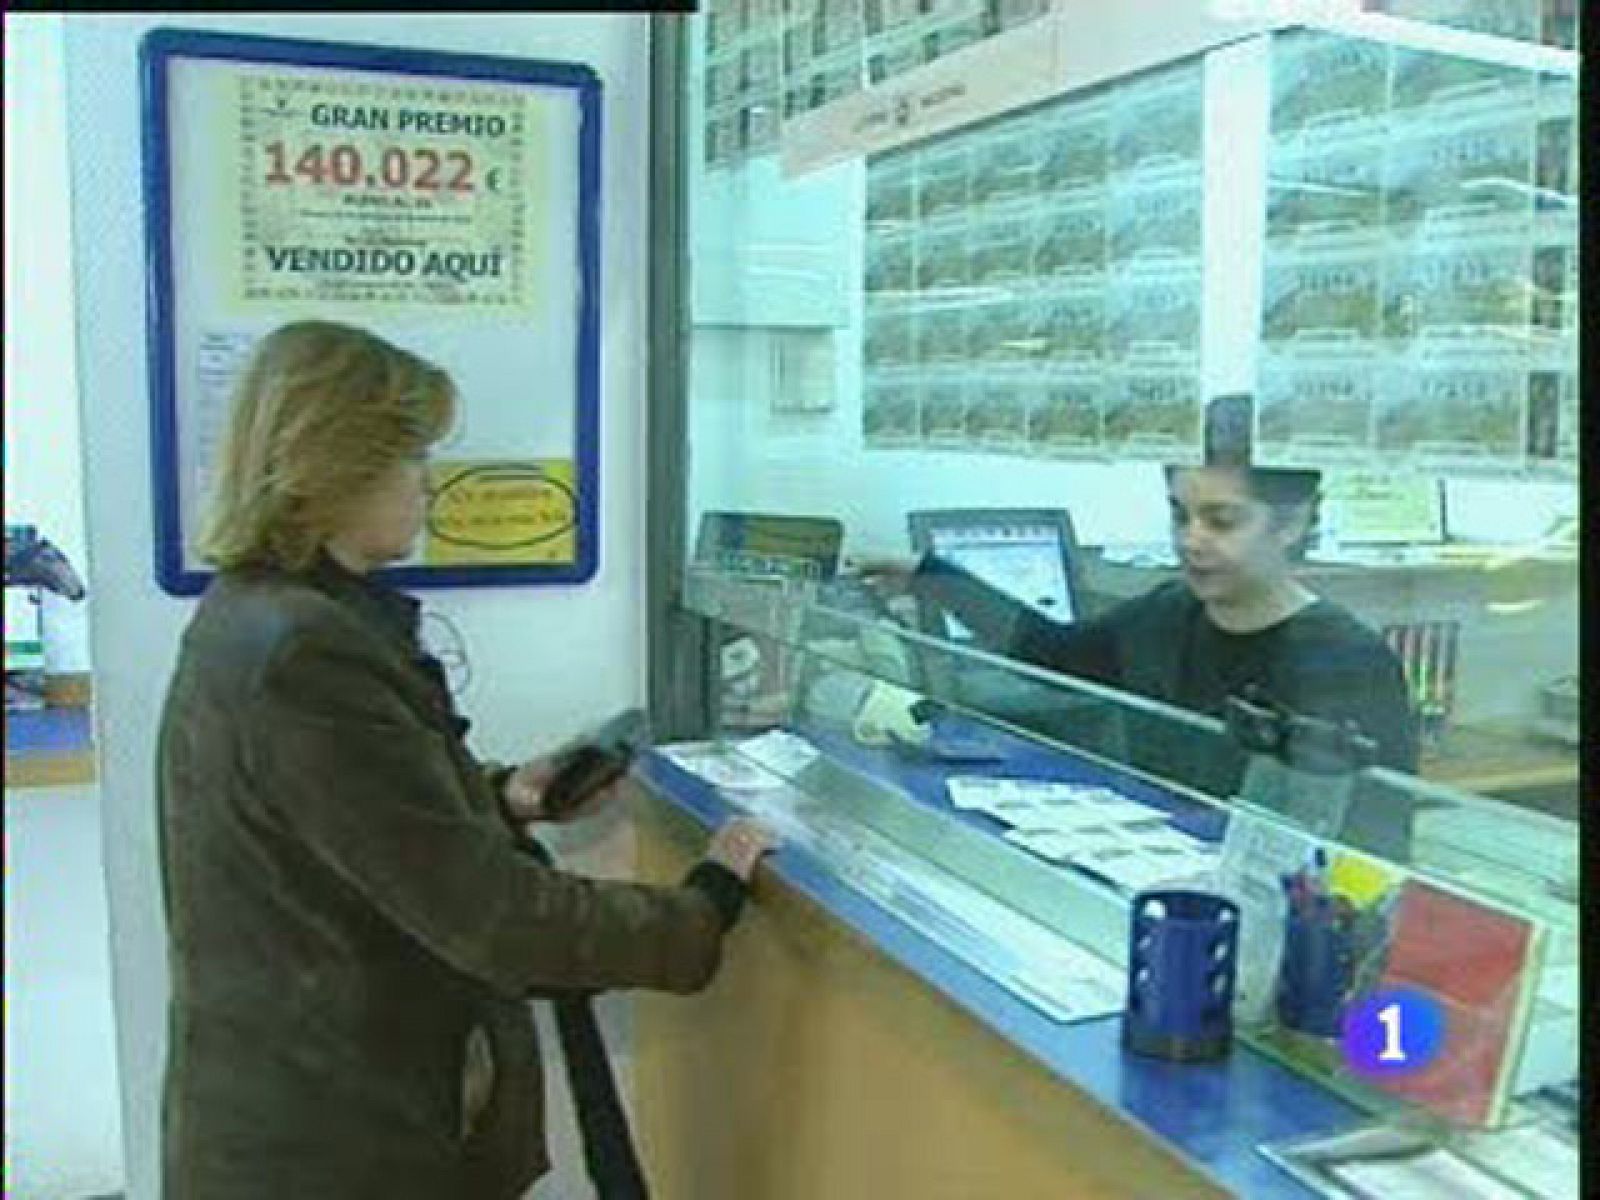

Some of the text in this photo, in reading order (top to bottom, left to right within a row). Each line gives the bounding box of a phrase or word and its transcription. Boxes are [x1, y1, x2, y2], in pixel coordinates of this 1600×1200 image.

[311, 103, 389, 130] GRAN
[399, 109, 506, 138] PREMIO
[263, 140, 501, 193] 140.022 €
[264, 246, 415, 276] VENDIDO
